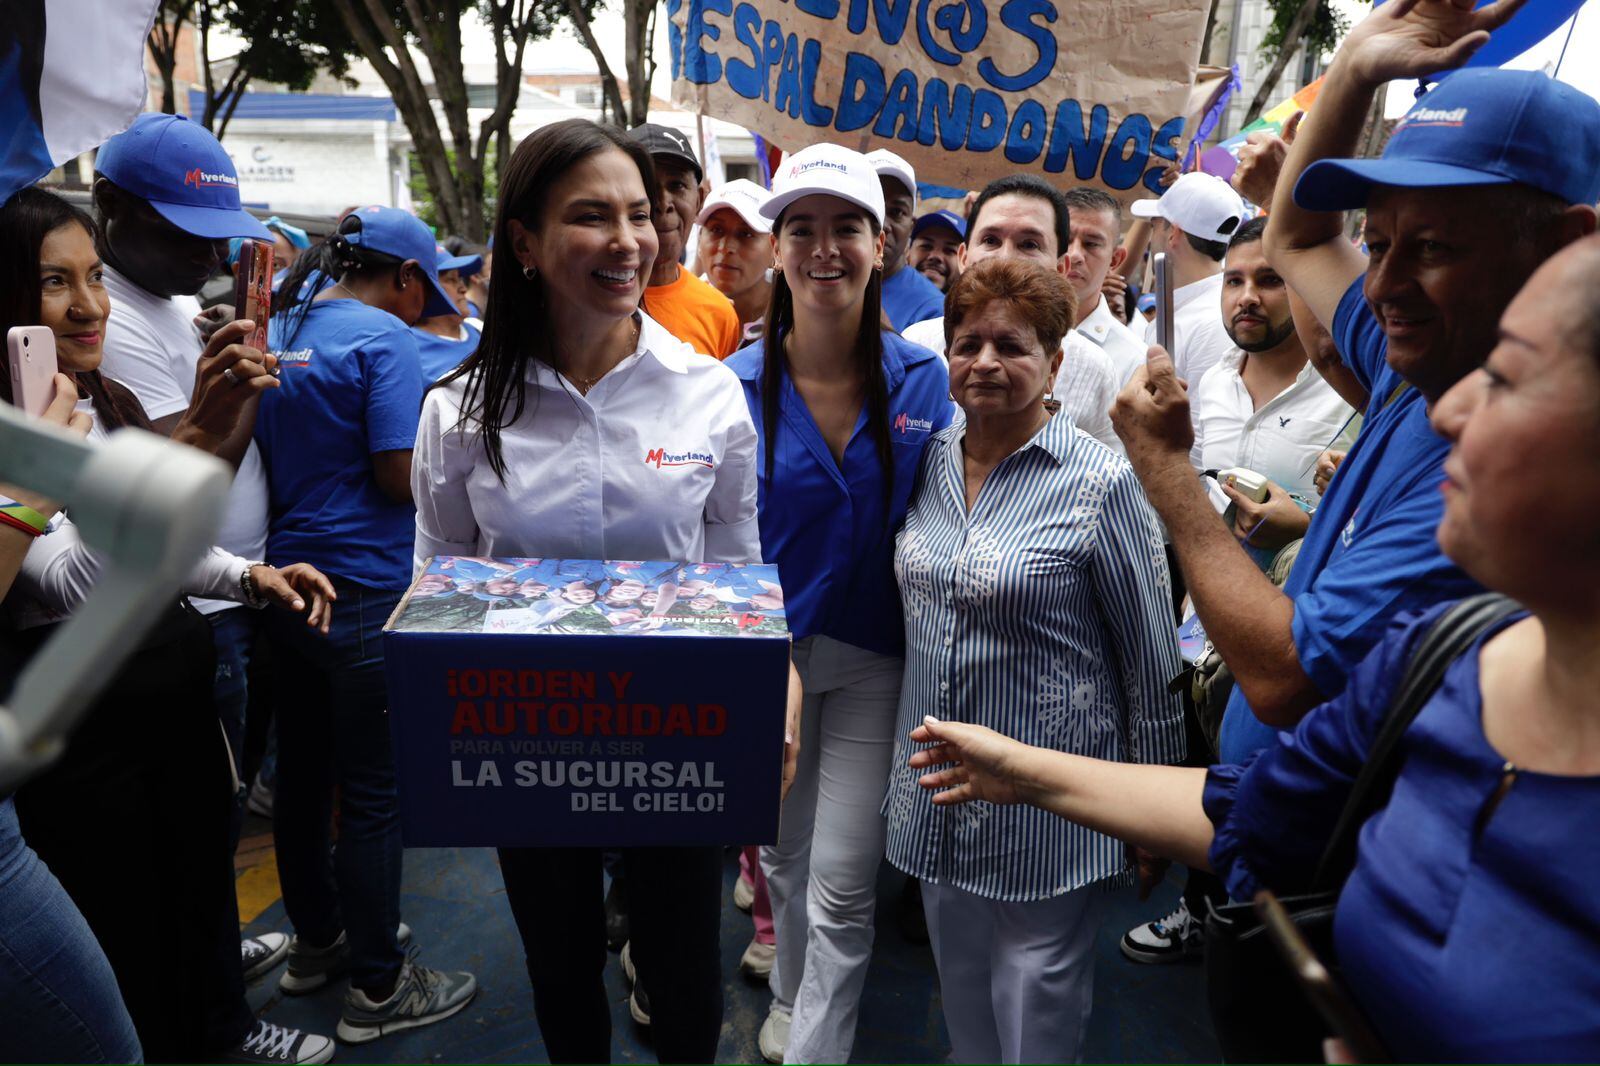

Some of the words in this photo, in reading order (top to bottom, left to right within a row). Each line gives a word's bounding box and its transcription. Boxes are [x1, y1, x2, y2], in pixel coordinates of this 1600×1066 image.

[789, 158, 848, 178] Miyerlandi
[645, 448, 713, 469] Miyerlandi
[447, 669, 596, 699] ¡ORDEN
[608, 671, 632, 699] Y
[452, 701, 727, 737] AUTORIDAD
[451, 740, 503, 755] PARA
[509, 740, 584, 755] VOLVER
[589, 741, 603, 755] A
[607, 741, 644, 755] SER
[452, 760, 503, 787] LA
[514, 760, 725, 787] SUCURSAL
[571, 792, 624, 812] DEL
[633, 792, 725, 812] CIELO!
